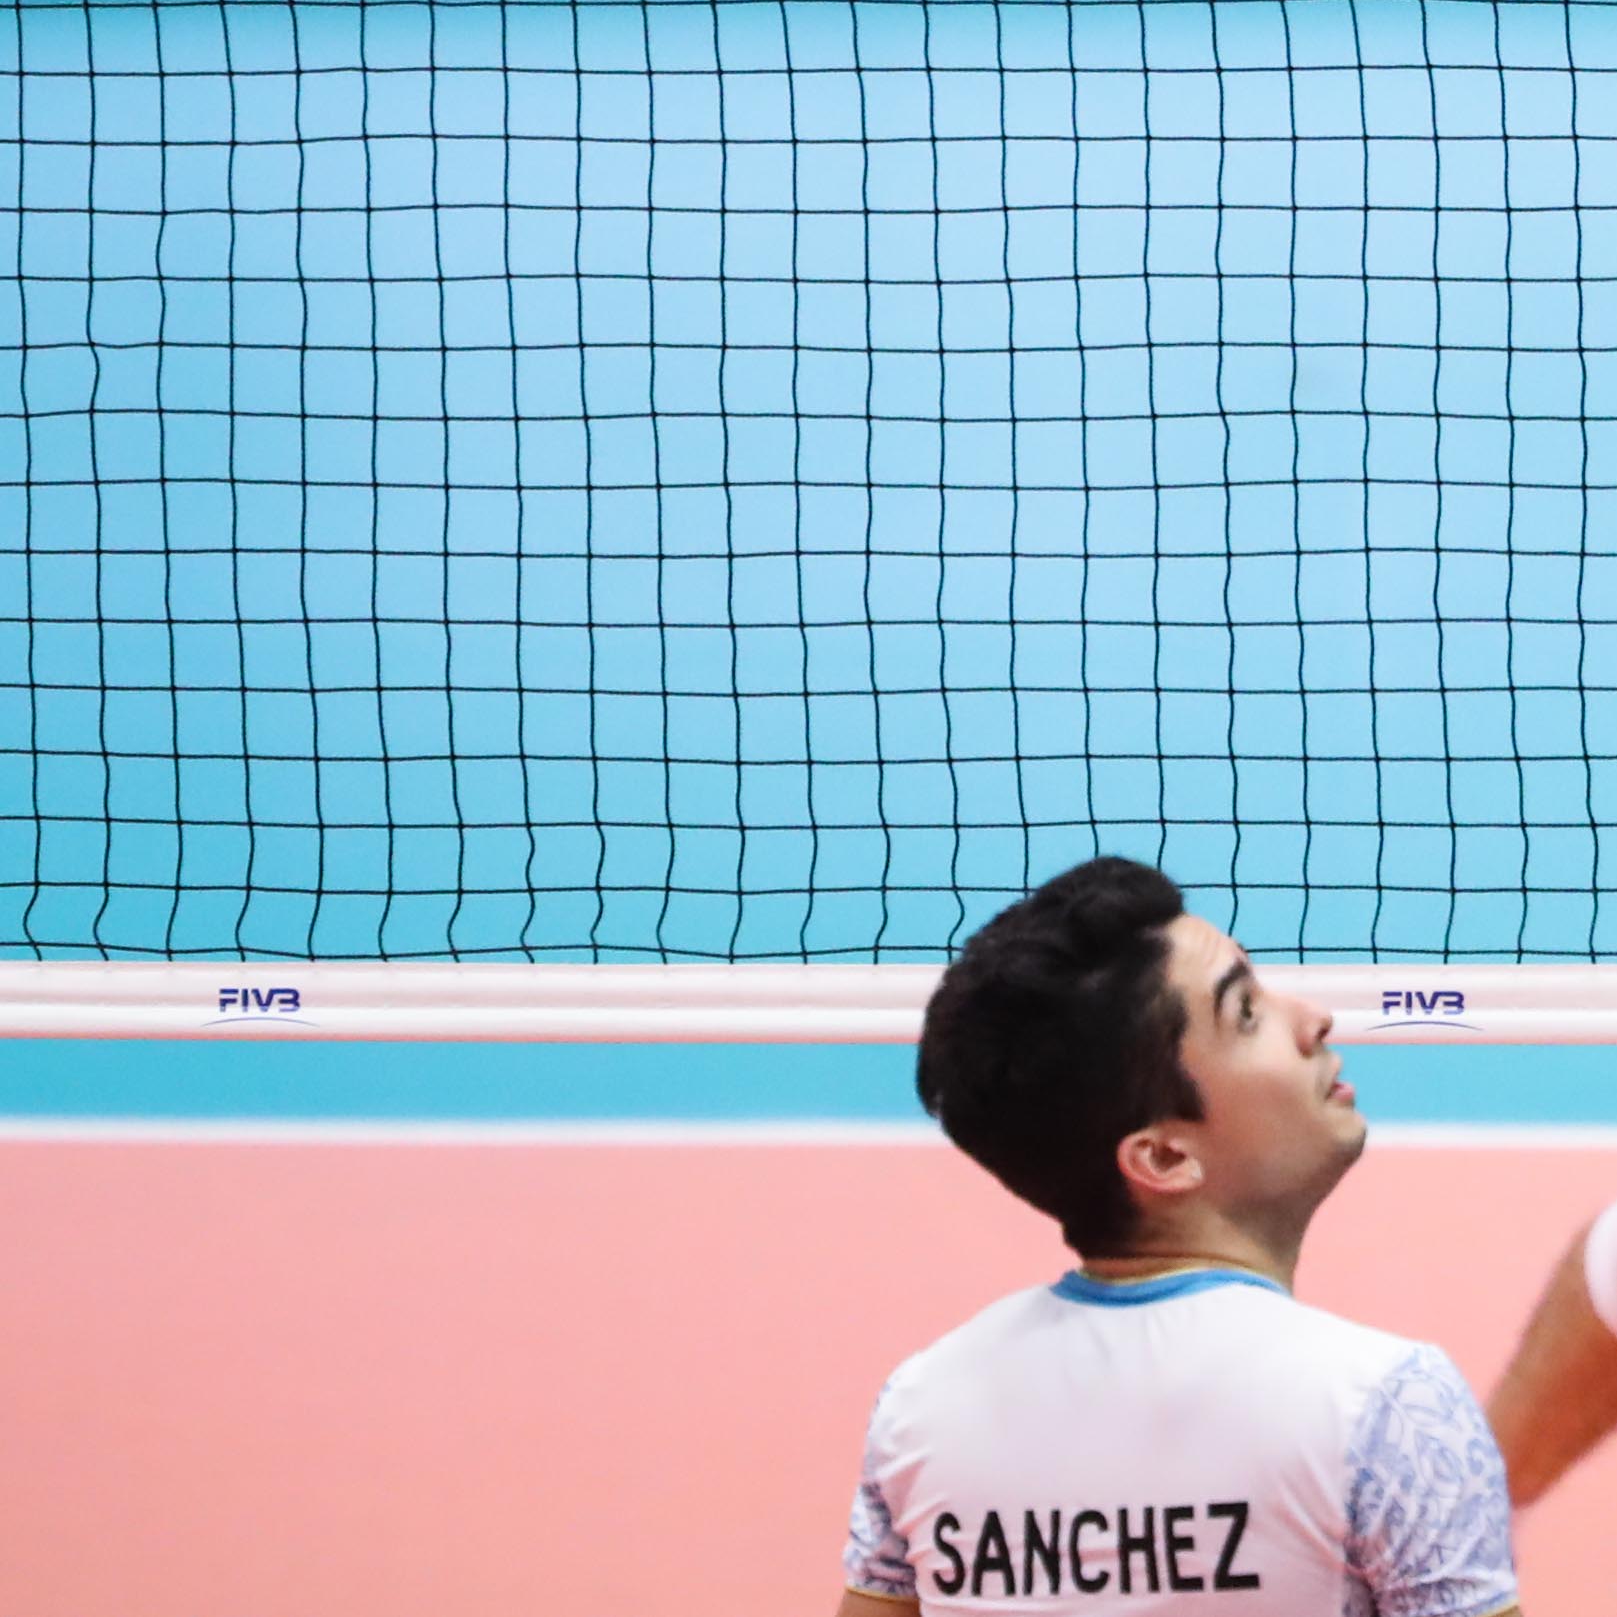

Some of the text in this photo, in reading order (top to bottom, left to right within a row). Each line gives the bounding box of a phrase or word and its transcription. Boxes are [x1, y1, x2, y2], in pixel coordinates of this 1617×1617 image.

[219, 987, 301, 1012] FIVB
[1382, 991, 1465, 1015] FIVB
[932, 1501, 1260, 1596] SANCHEZ
